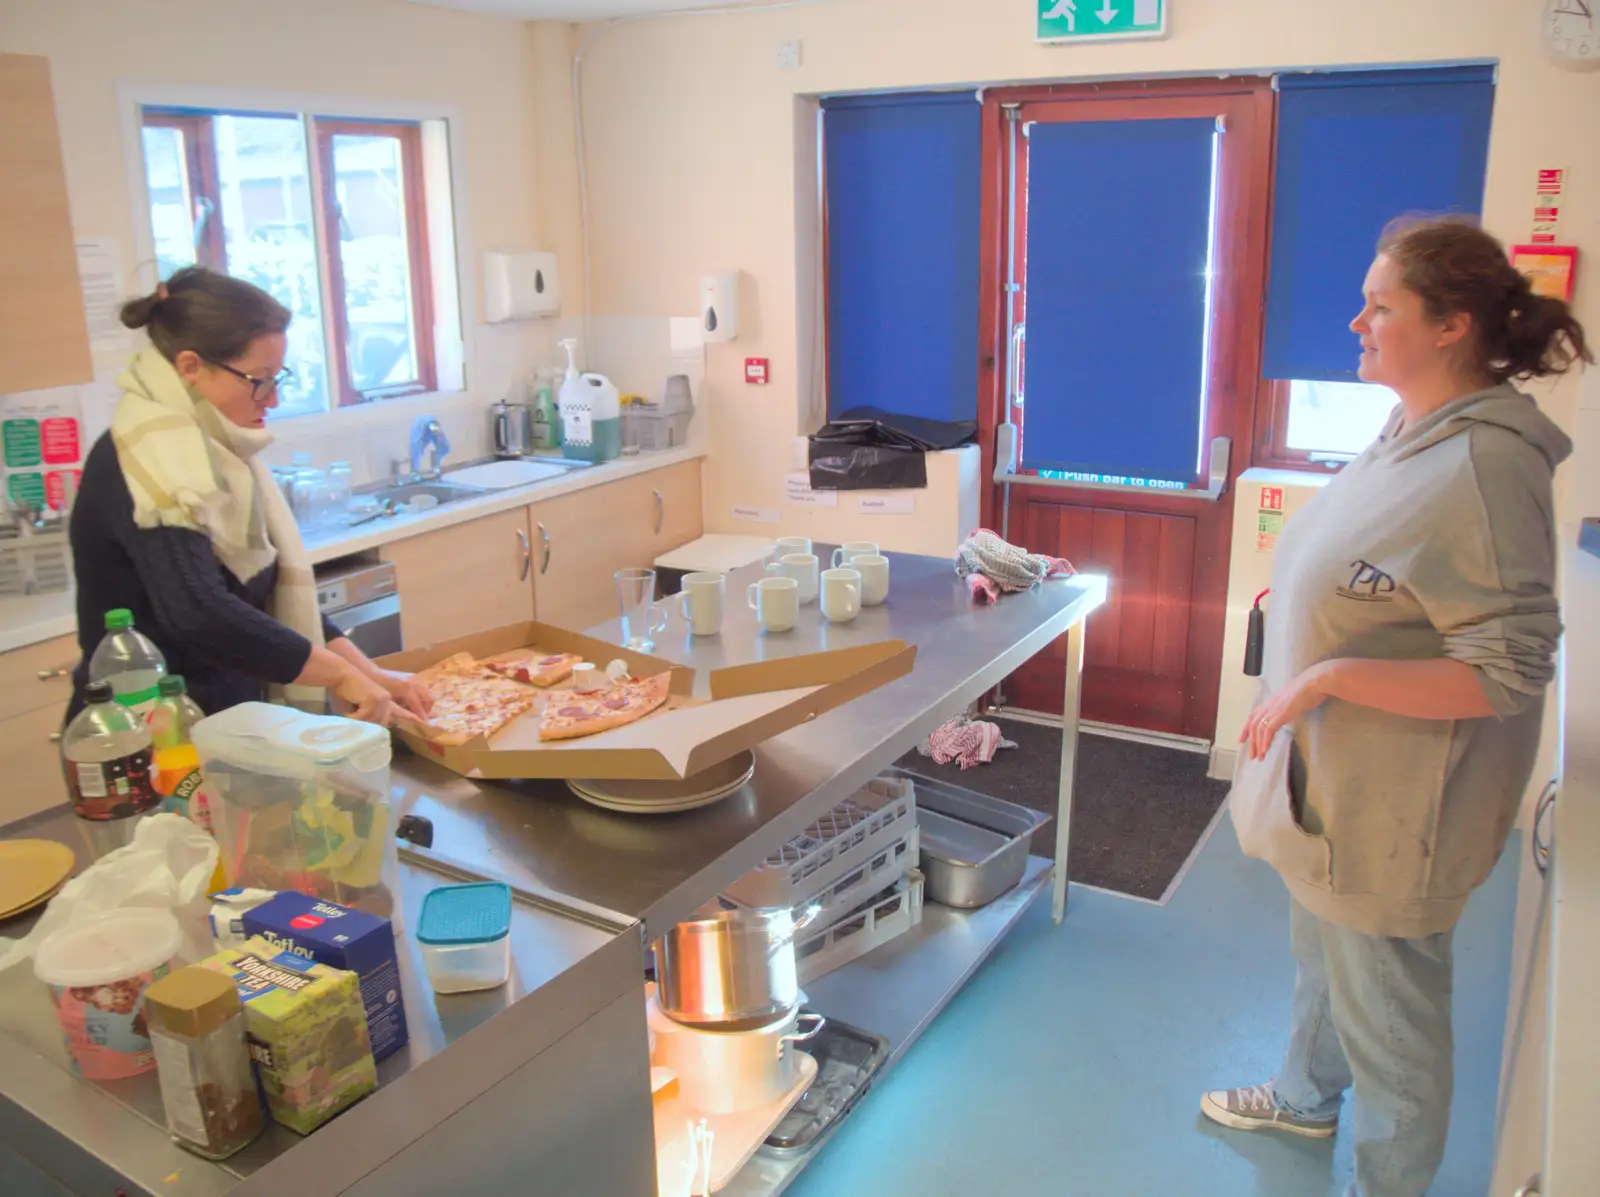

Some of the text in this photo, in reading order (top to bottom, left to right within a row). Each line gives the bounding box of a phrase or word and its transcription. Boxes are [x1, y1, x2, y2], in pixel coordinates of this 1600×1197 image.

[311, 902, 348, 919] Tetley
[235, 956, 312, 991] YORKSHIRE
[238, 974, 271, 991] TEA
